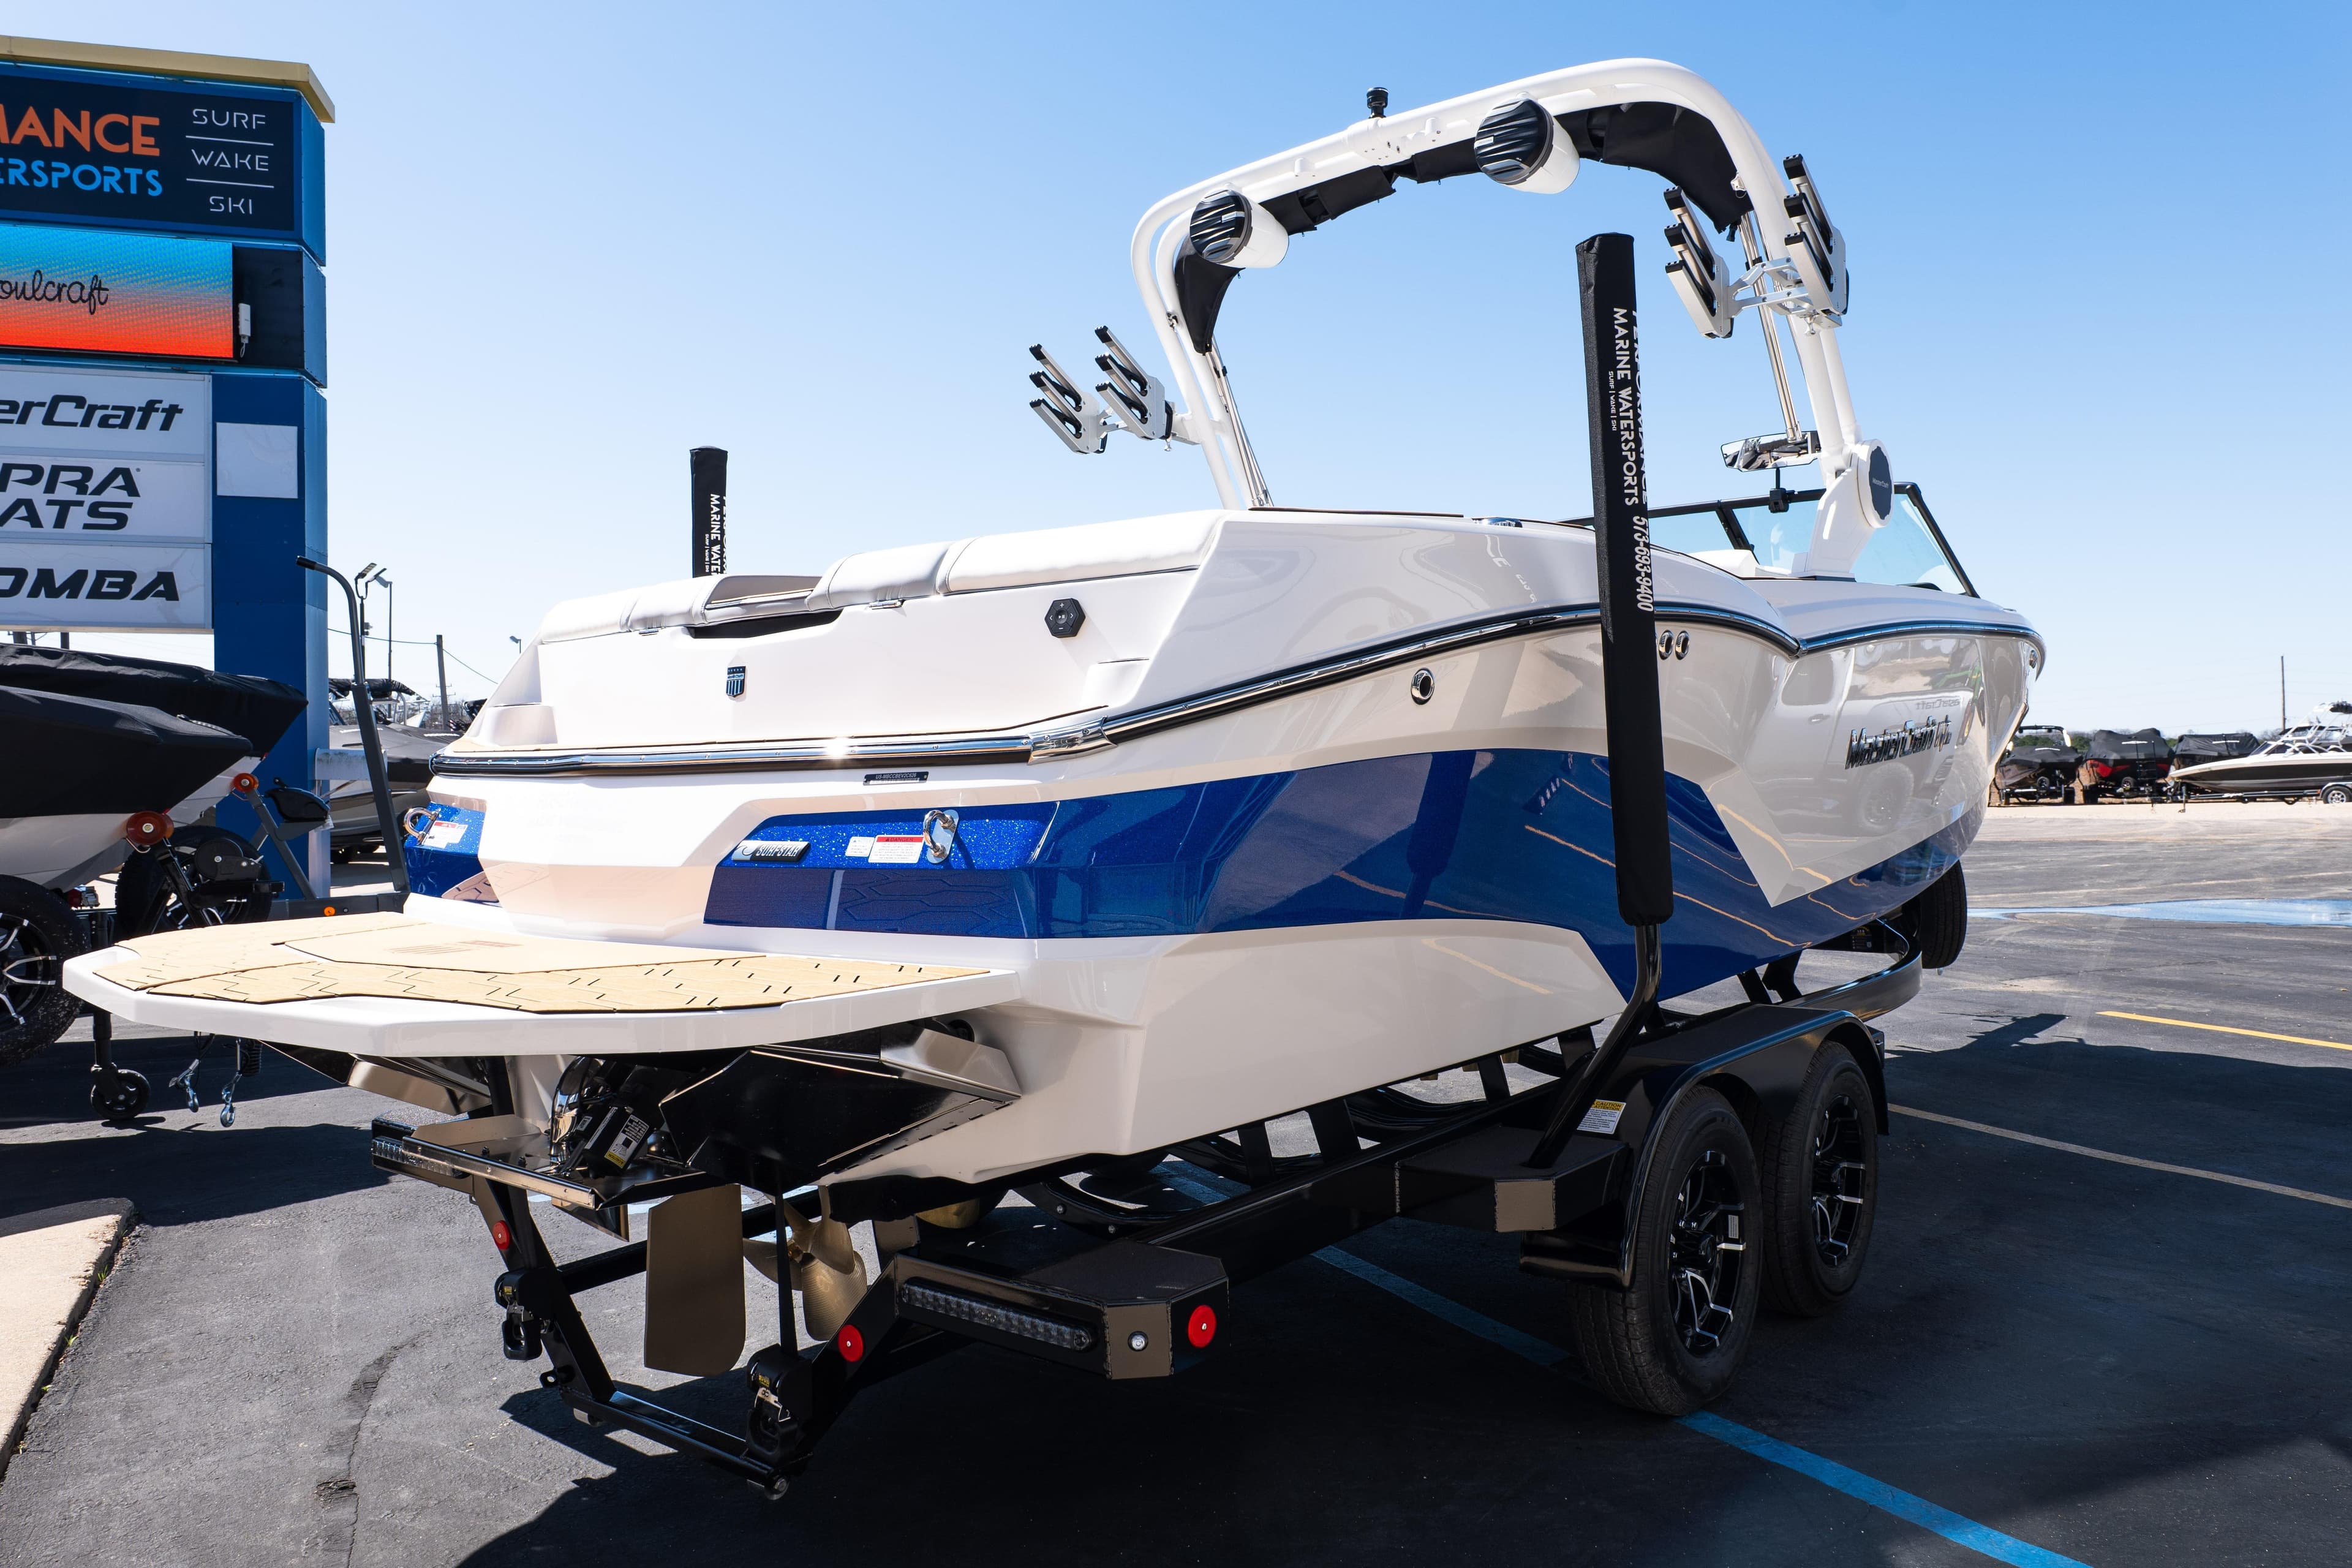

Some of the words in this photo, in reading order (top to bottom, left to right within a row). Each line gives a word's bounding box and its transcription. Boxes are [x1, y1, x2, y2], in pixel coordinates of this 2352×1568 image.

[0, 104, 160, 157] ANCE
[192, 108, 266, 129] SURF
[0, 157, 162, 196] RSPORTS
[191, 149, 269, 171] WAKE
[209, 196, 252, 214] SKI
[1613, 307, 1631, 380] MARINE
[1618, 386, 1638, 506] WATERSPORTS
[710, 494, 721, 540] MARINE
[1632, 515, 1653, 612] 573-693-9400
[756, 844, 801, 857] SURFSTAR
